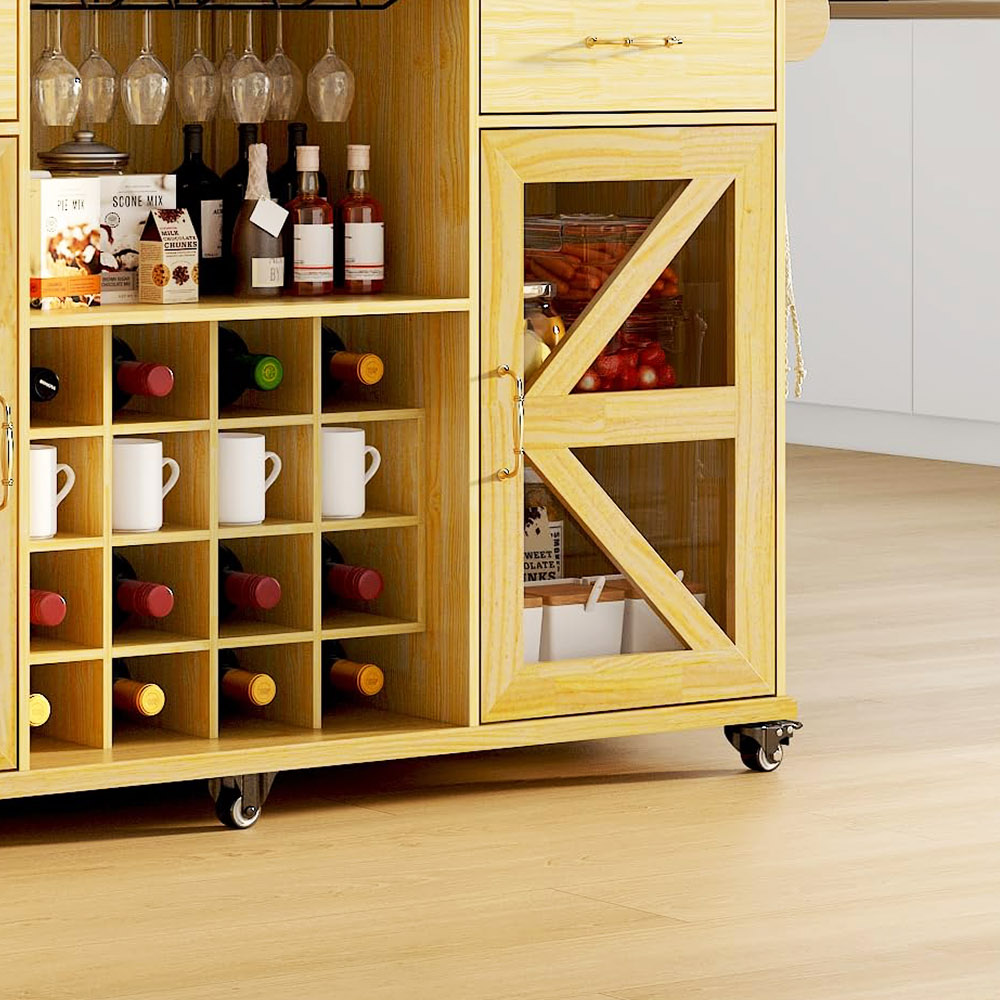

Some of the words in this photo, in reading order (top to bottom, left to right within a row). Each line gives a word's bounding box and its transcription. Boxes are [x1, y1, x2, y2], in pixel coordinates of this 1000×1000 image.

[72, 199, 85, 211] MIX
[112, 195, 142, 208] SCONE
[146, 194, 163, 207] MIX
[524, 572, 556, 581] NKS
